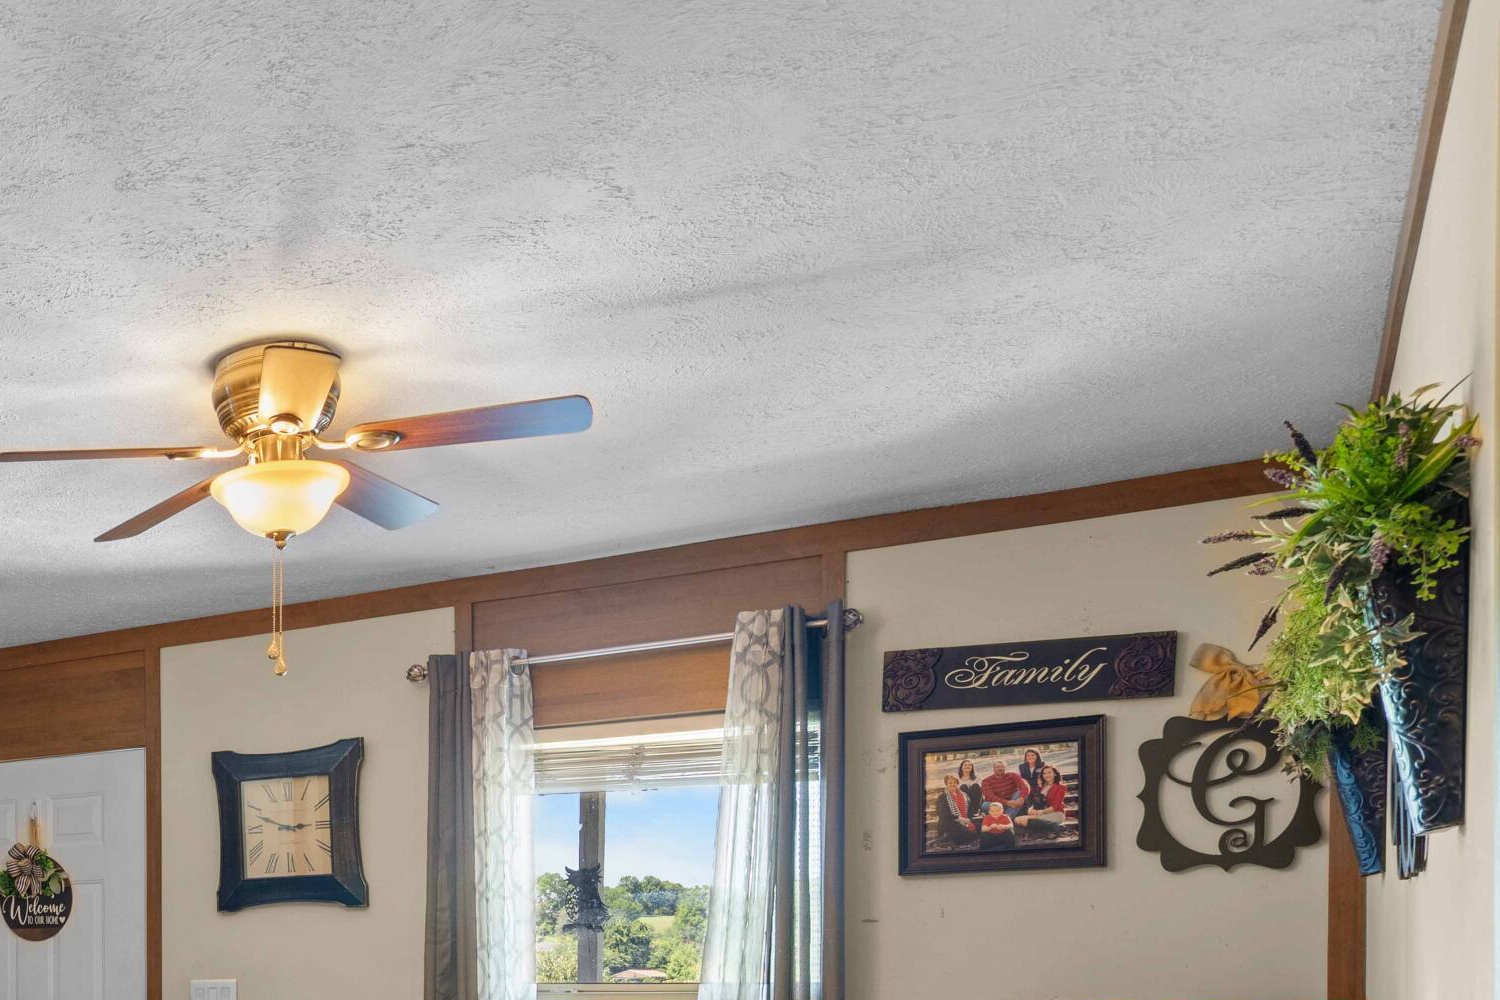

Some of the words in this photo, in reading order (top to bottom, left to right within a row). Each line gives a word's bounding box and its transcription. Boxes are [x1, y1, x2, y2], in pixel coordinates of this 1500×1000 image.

[944, 647, 1108, 692] Family
[2, 895, 66, 925] Welcome
[27, 915, 34, 925] TO
[34, 915, 45, 925] OUR
